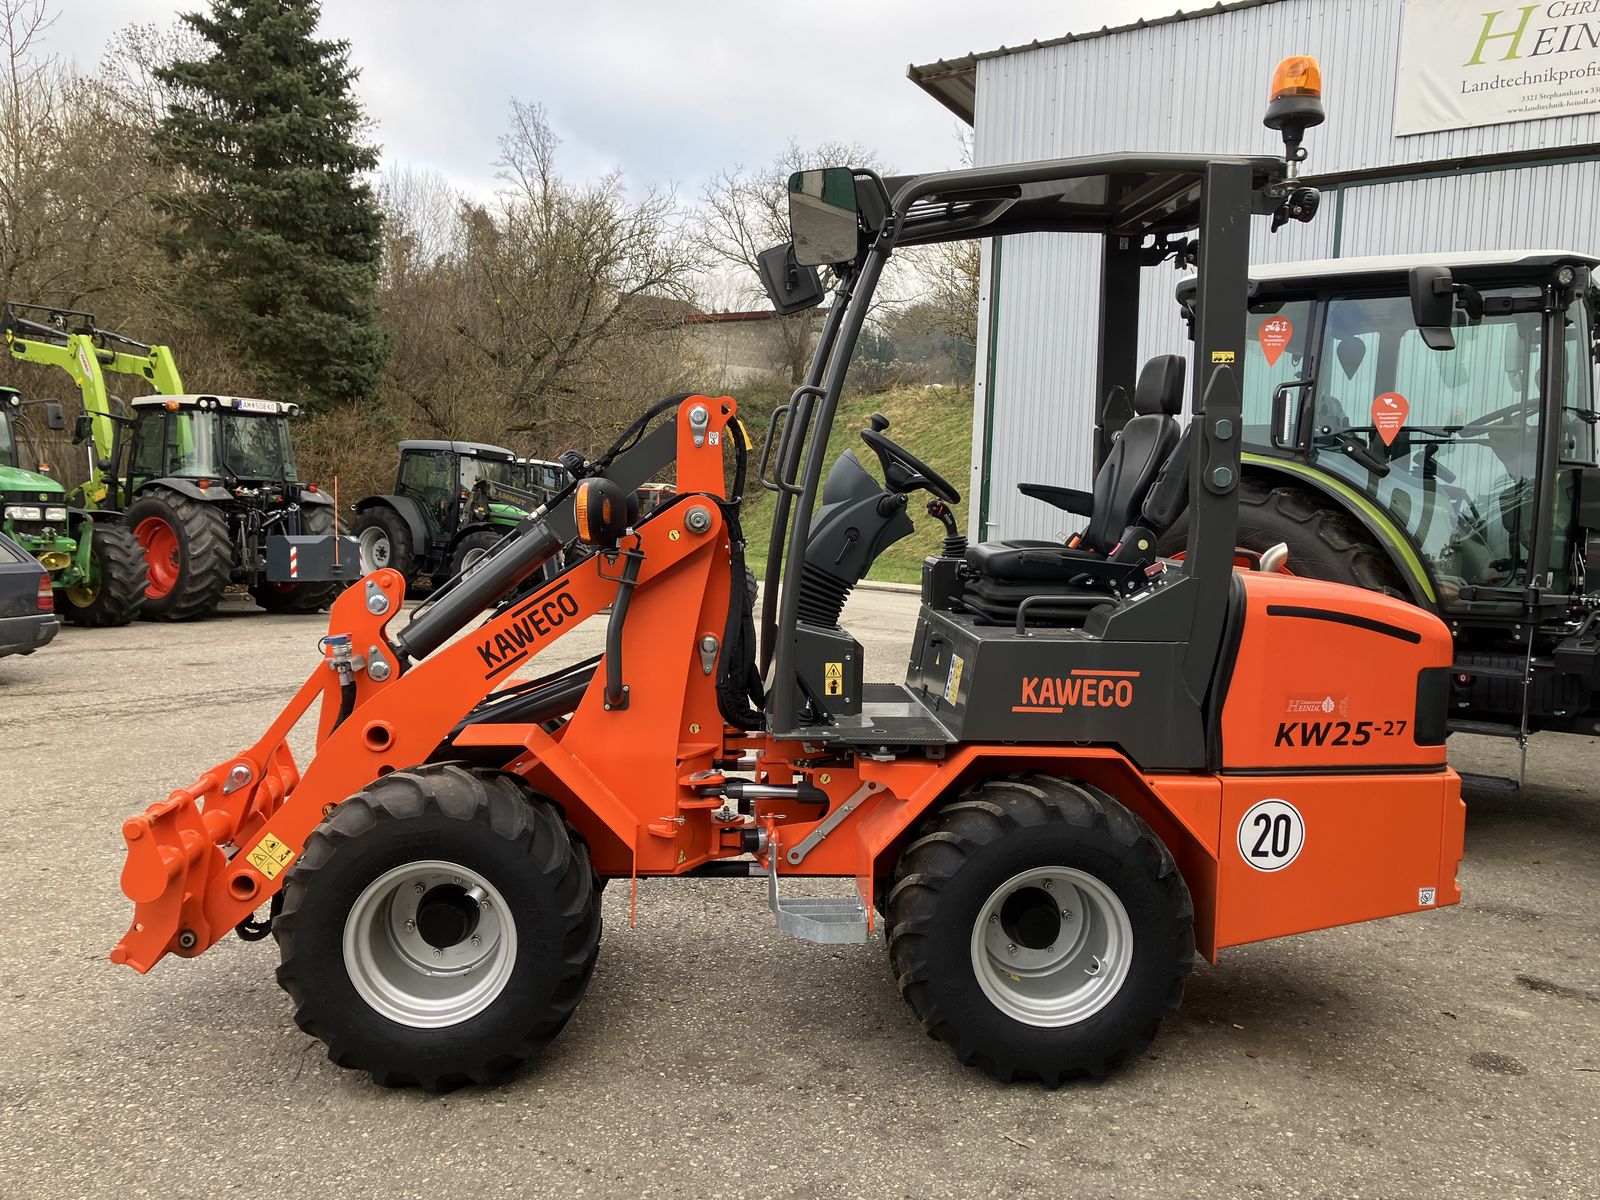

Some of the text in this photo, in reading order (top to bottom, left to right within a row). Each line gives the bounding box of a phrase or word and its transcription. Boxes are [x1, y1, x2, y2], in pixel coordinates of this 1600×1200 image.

[1507, 98, 1597, 114] www.landtechnik-heindl.at
[1521, 94, 1538, 103] 3321
[1539, 89, 1583, 101] Stephanshart
[476, 592, 579, 669] KAWECO
[1021, 676, 1133, 708] KAWECO
[1251, 813, 1292, 858] 20
